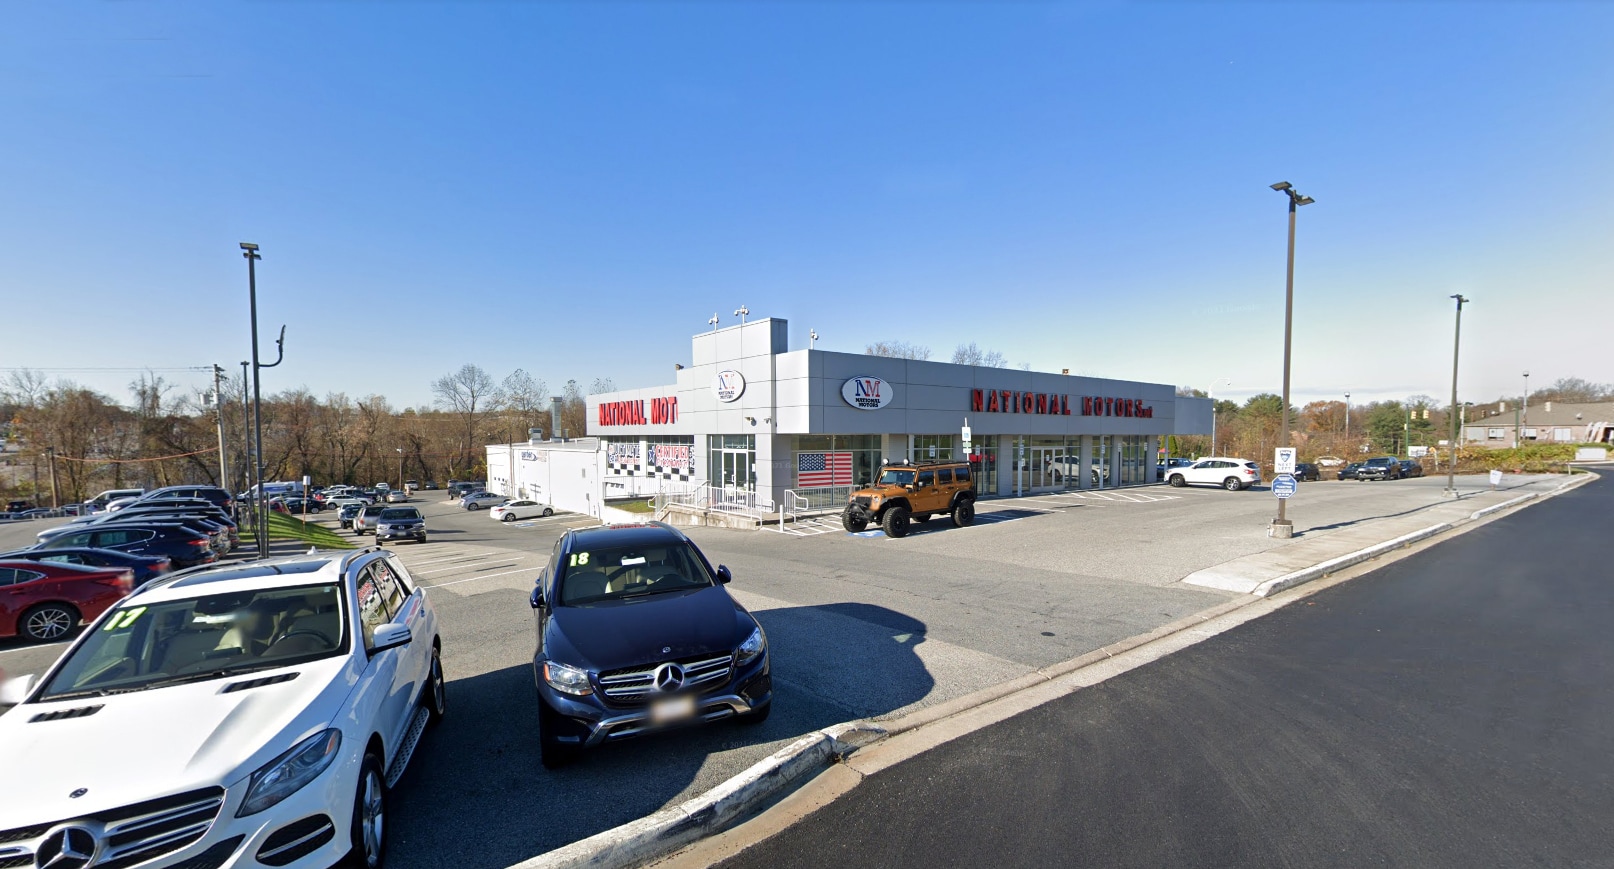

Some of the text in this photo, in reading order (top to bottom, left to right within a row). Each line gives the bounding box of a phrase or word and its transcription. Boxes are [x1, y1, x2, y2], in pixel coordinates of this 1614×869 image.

[855, 379, 880, 397] NM
[598, 396, 679, 426] NATIONAL MOT
[972, 388, 1071, 416] NATIONAL
[655, 445, 689, 459] CERTIFIED
[570, 552, 590, 567] 18
[103, 606, 147, 631] 17
